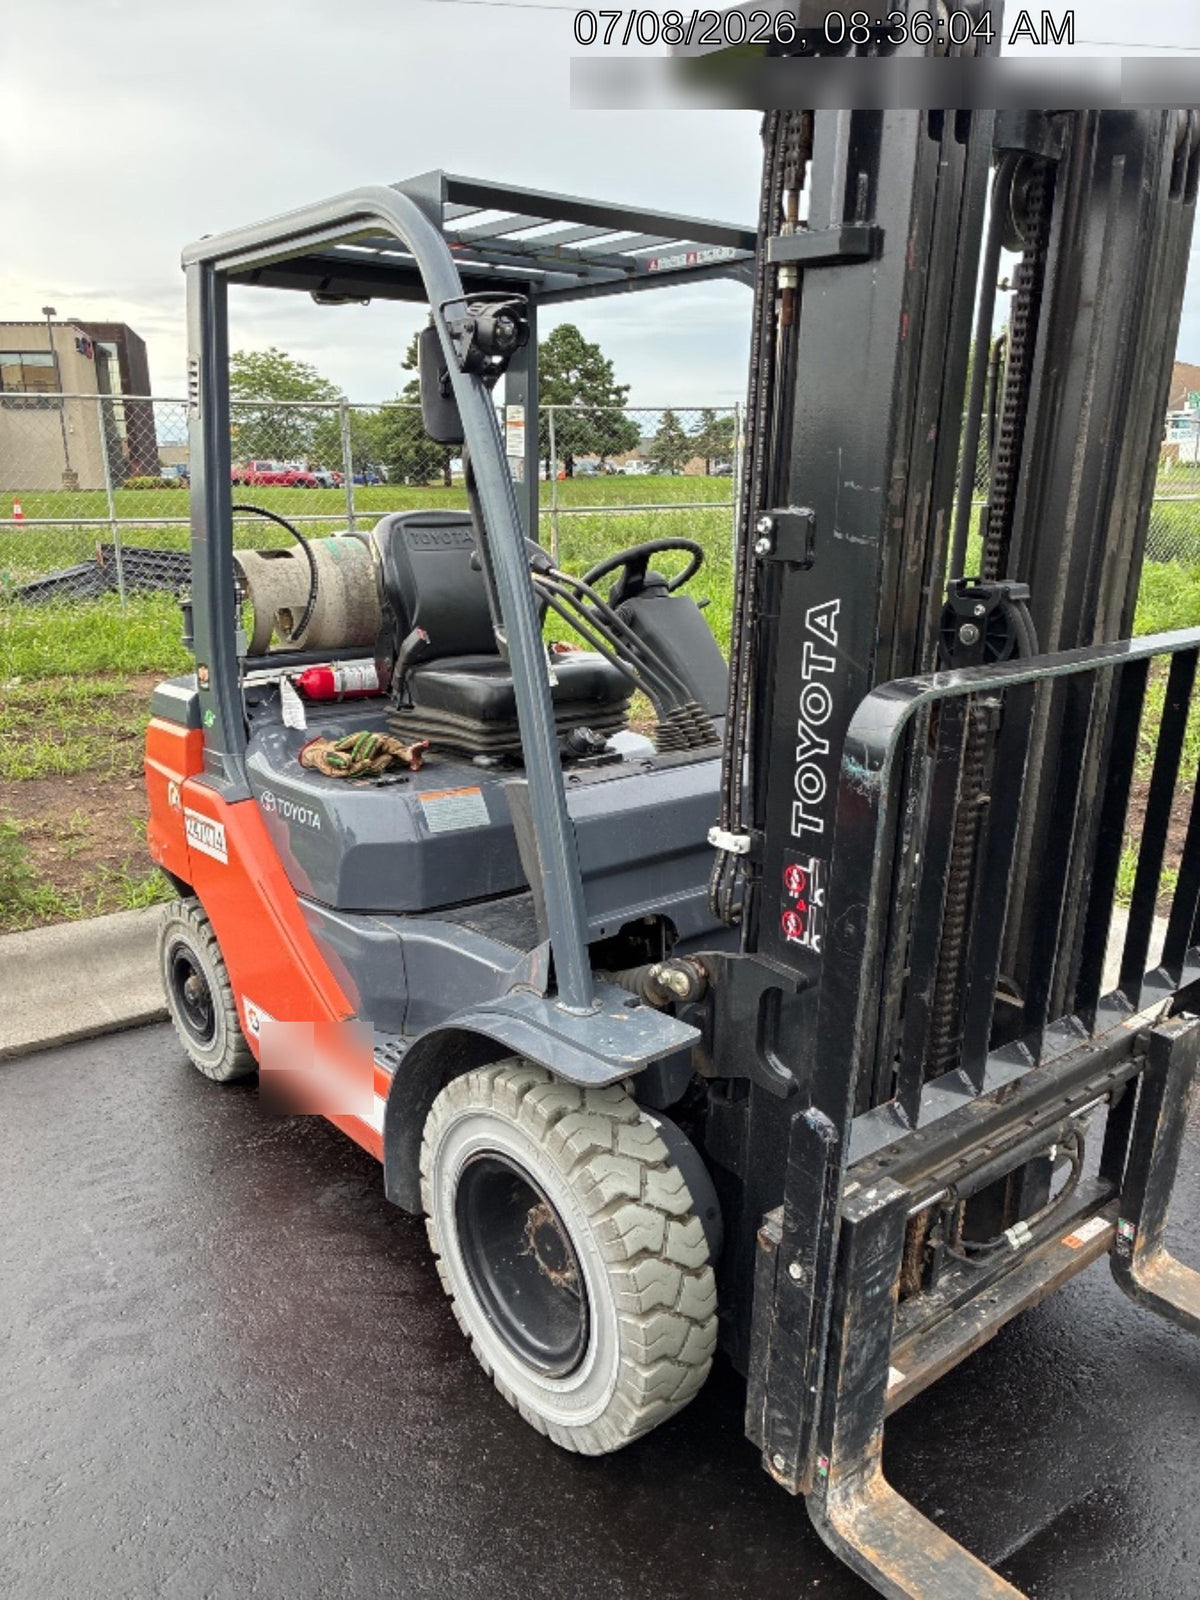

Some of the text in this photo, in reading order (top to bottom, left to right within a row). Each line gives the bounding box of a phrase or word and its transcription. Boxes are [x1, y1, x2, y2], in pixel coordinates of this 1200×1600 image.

[409, 530, 474, 545] TOYOTA
[790, 598, 841, 838] TOYOTA
[276, 797, 321, 831] TOYOTA
